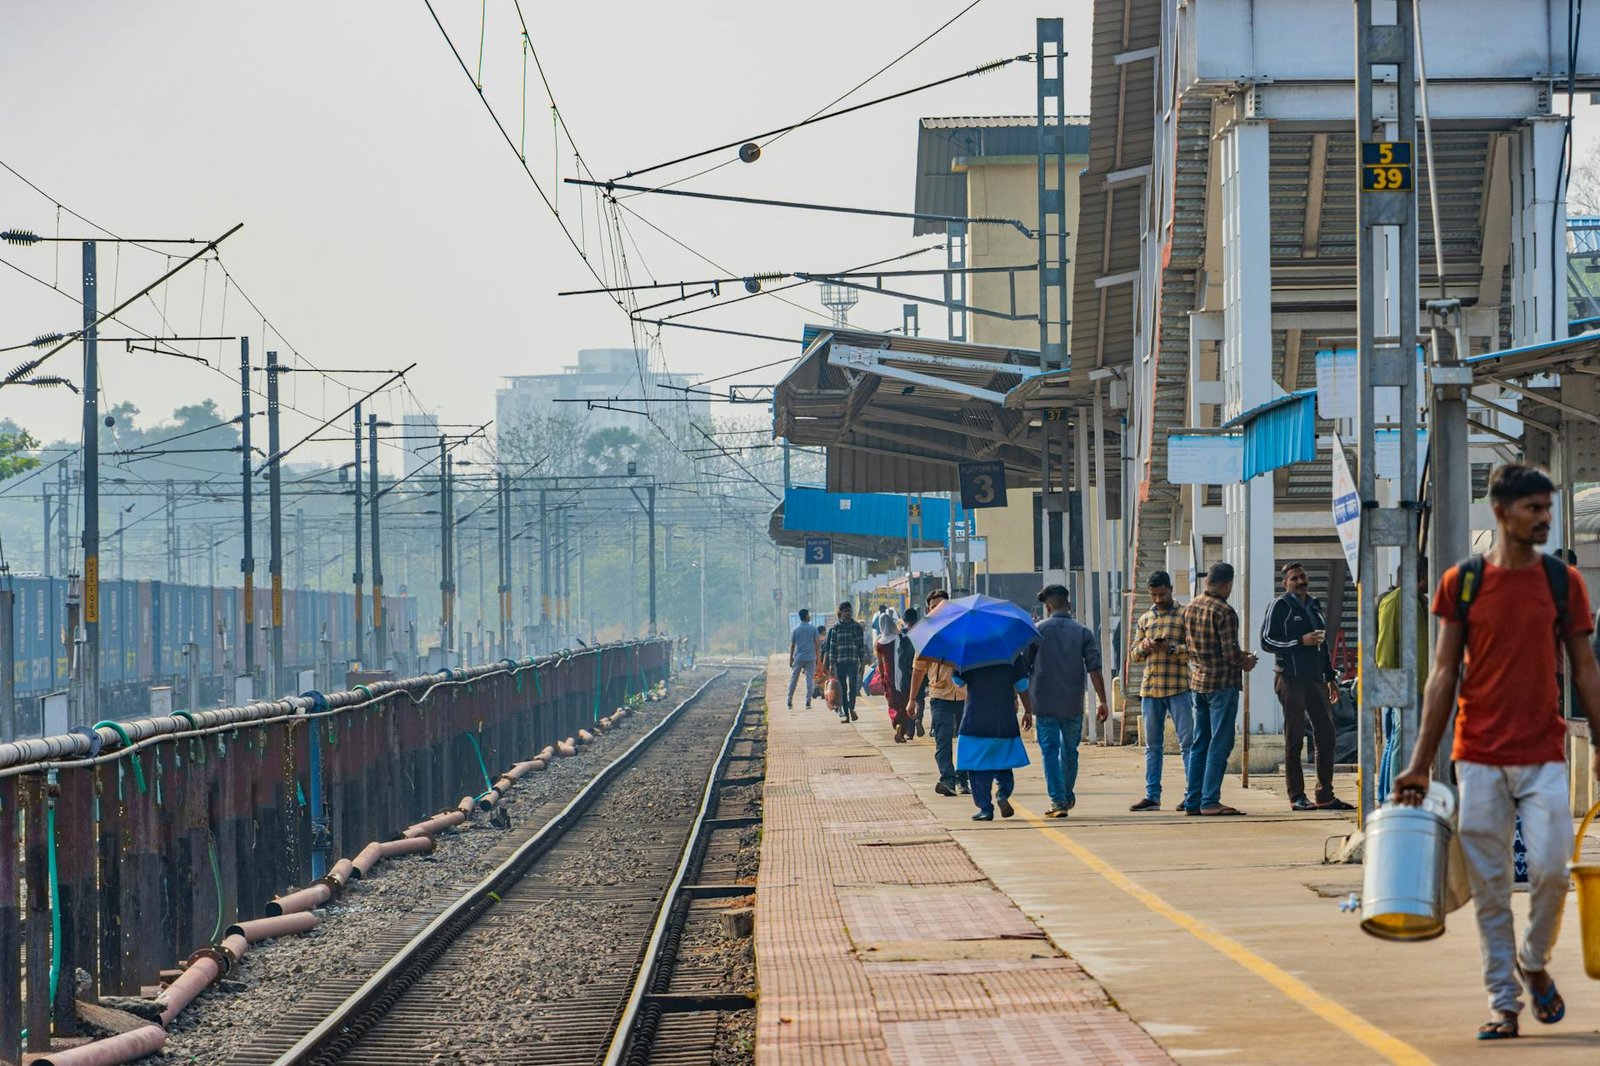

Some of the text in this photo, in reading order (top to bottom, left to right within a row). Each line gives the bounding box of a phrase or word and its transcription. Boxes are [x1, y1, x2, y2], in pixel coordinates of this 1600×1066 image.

[1379, 144, 1393, 164] 5
[1373, 169, 1403, 189] 39
[974, 474, 995, 503] 3
[813, 546, 825, 561] 3
